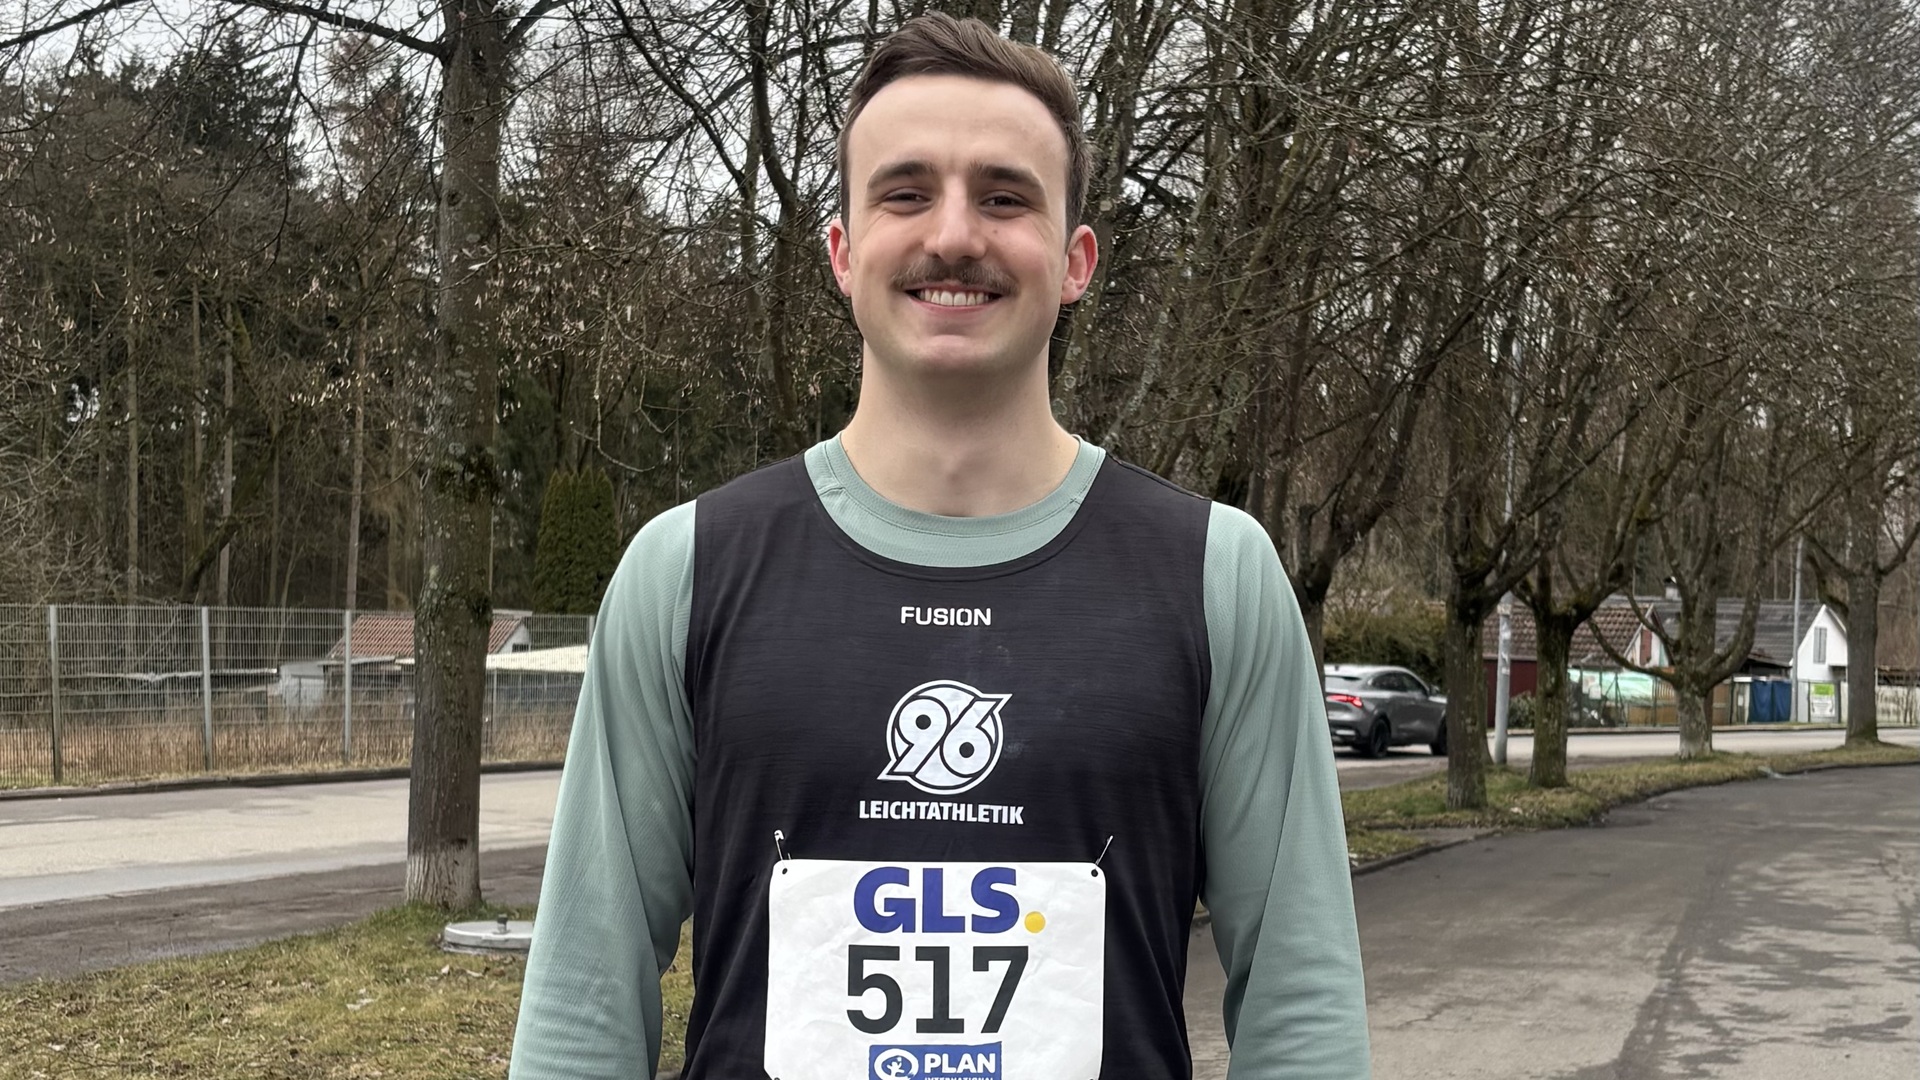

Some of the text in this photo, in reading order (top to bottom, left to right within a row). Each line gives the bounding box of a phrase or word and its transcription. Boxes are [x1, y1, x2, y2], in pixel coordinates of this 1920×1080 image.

[900, 606, 992, 626] FUSION
[891, 697, 999, 777] 96
[859, 800, 1024, 824] LEICHTATHLETIK
[846, 944, 1029, 1034] 517
[924, 1052, 996, 1074] PLAN
